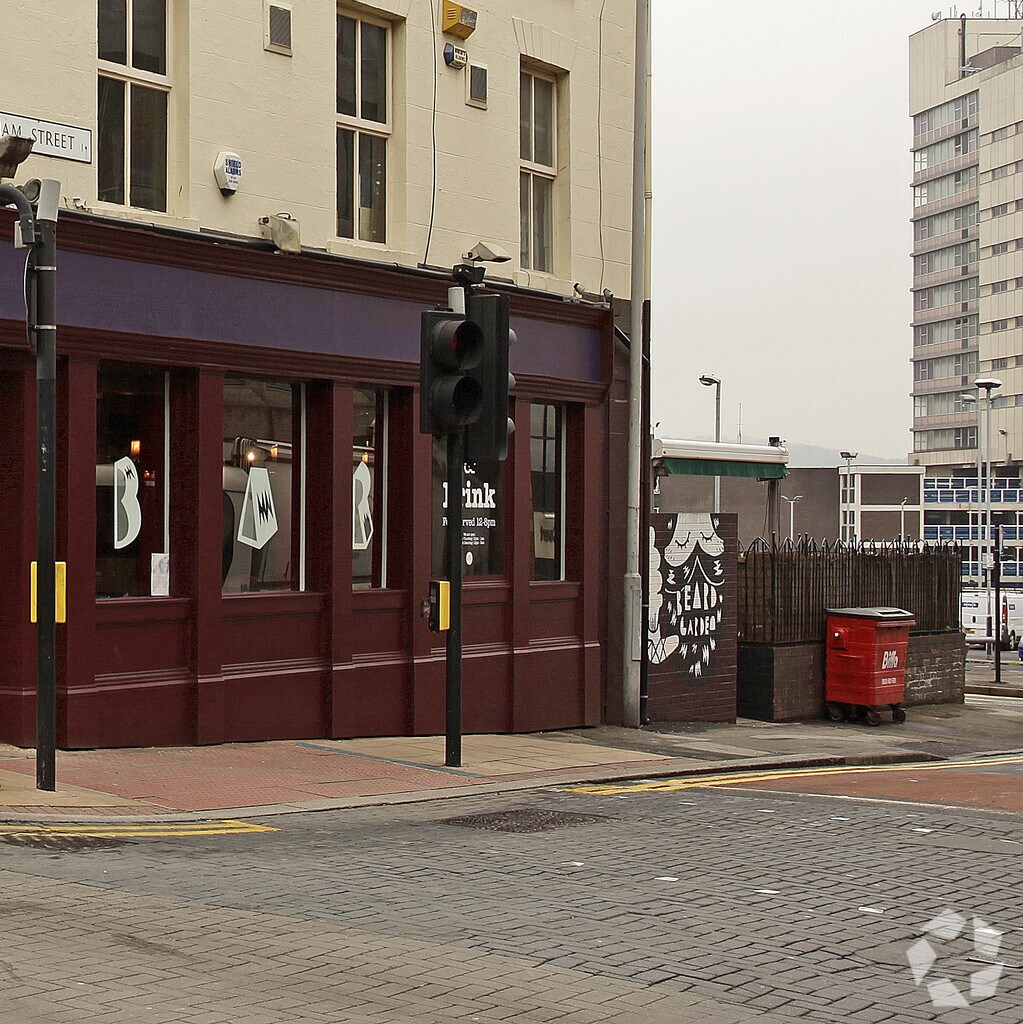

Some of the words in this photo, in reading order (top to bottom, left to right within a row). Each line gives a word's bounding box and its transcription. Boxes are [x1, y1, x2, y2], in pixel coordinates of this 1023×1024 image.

[32, 128, 75, 150] STREET
[676, 581, 717, 616] BEARD
[680, 616, 716, 636] GARDEN
